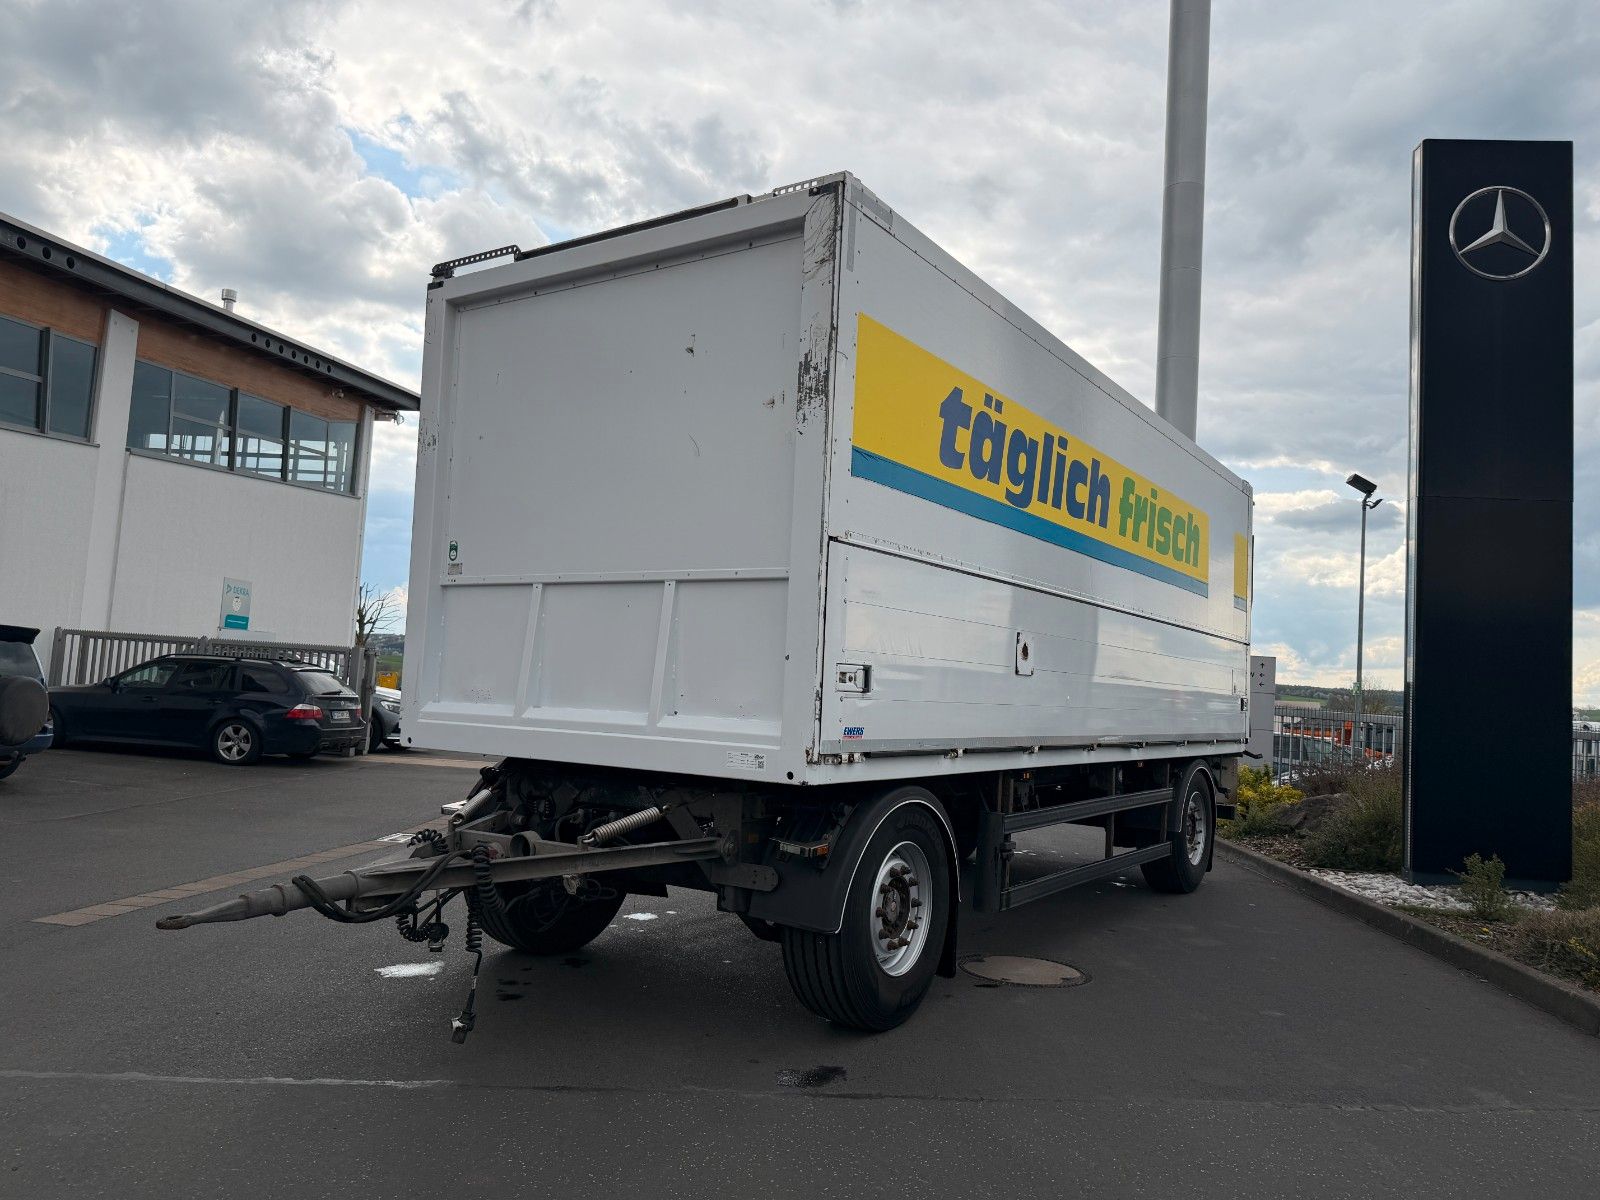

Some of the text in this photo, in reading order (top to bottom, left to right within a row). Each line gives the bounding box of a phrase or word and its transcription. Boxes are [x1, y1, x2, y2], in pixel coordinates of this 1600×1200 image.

[939, 386, 1200, 568] täglich frisch
[843, 726, 865, 735] EWERS
